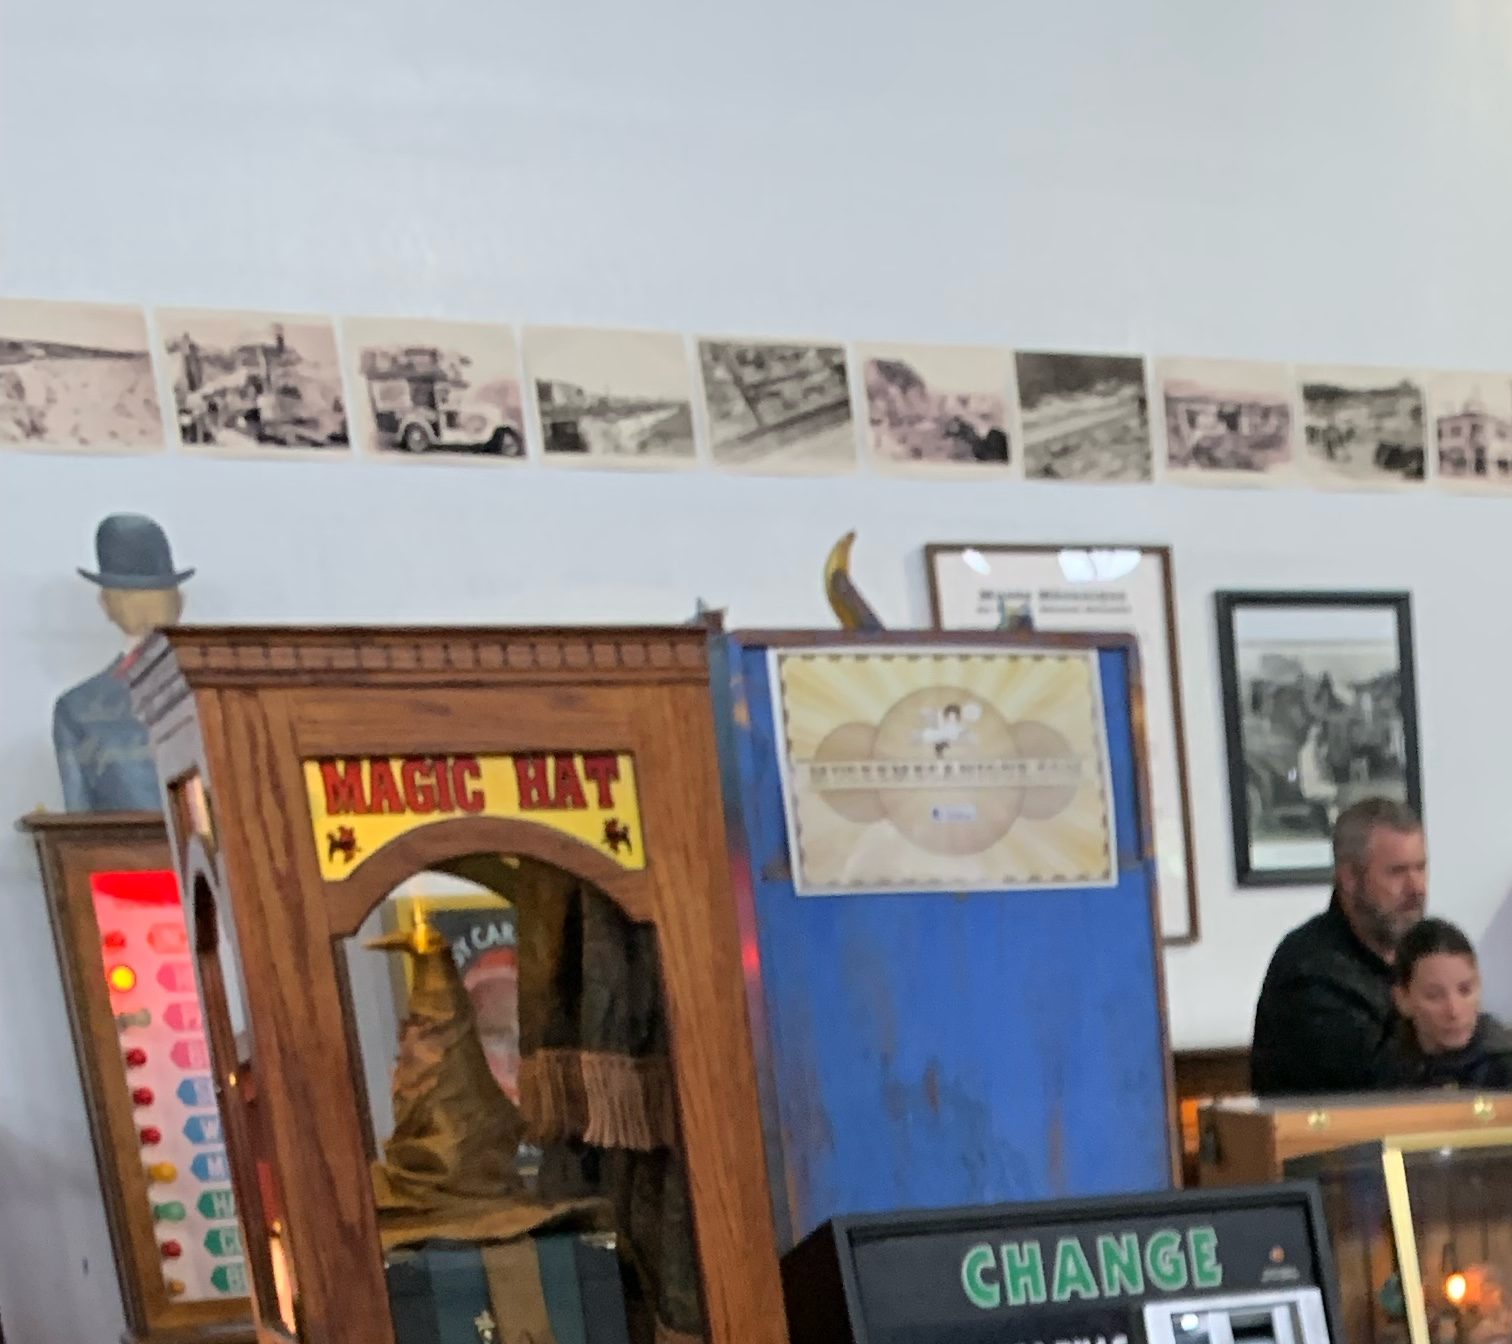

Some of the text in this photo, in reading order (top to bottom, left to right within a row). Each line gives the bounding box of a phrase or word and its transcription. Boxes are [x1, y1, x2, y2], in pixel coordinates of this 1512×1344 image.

[319, 752, 620, 816] MAGIC HAT
[961, 1226, 1223, 1309] CHANGE
